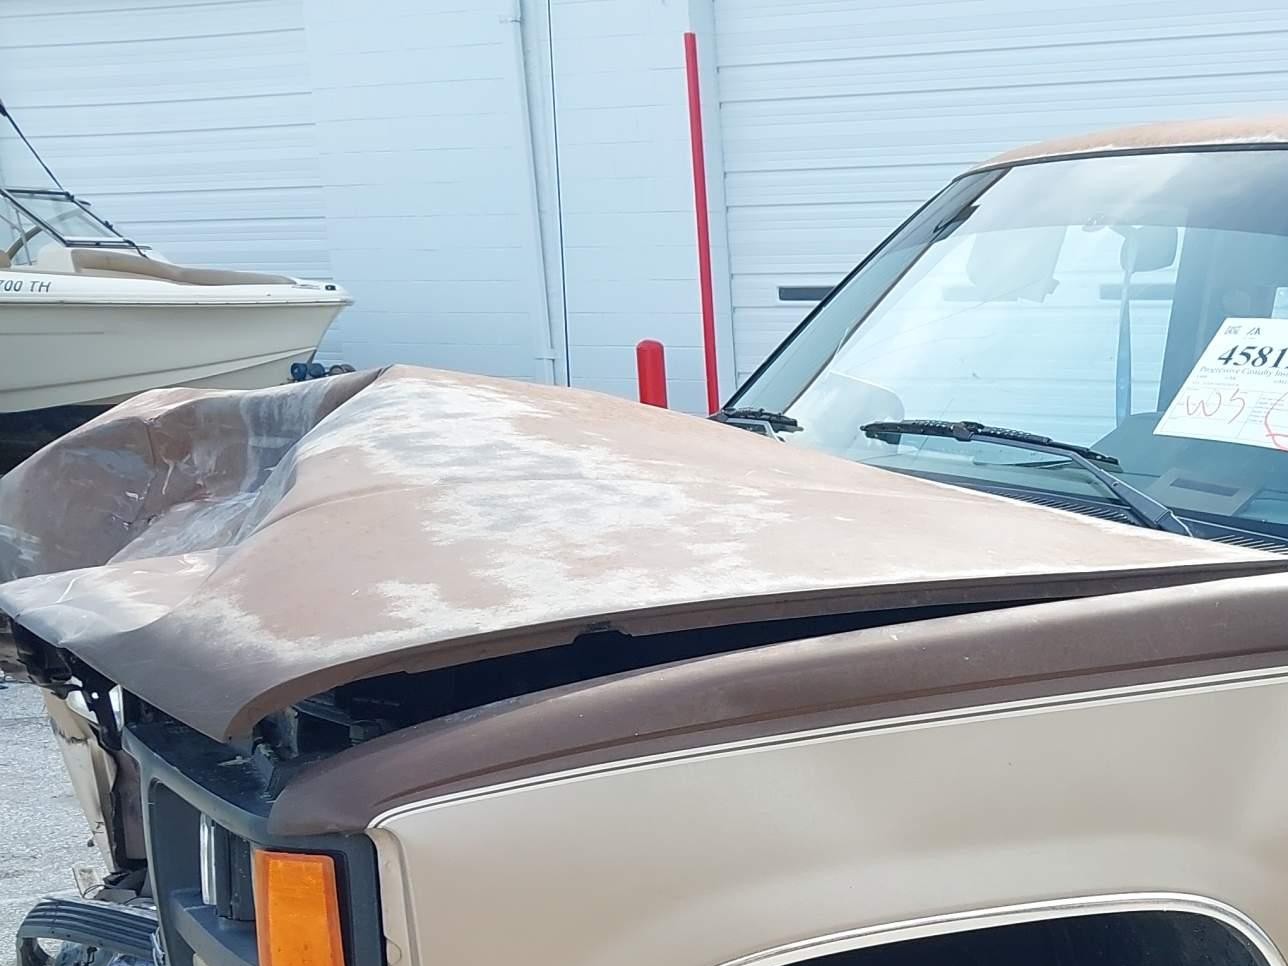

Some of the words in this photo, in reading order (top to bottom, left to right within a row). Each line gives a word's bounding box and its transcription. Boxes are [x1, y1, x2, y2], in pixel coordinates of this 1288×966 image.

[30, 281, 52, 293] TH
[1200, 366, 1240, 375] Progressive
[1241, 368, 1272, 377] Casualty
